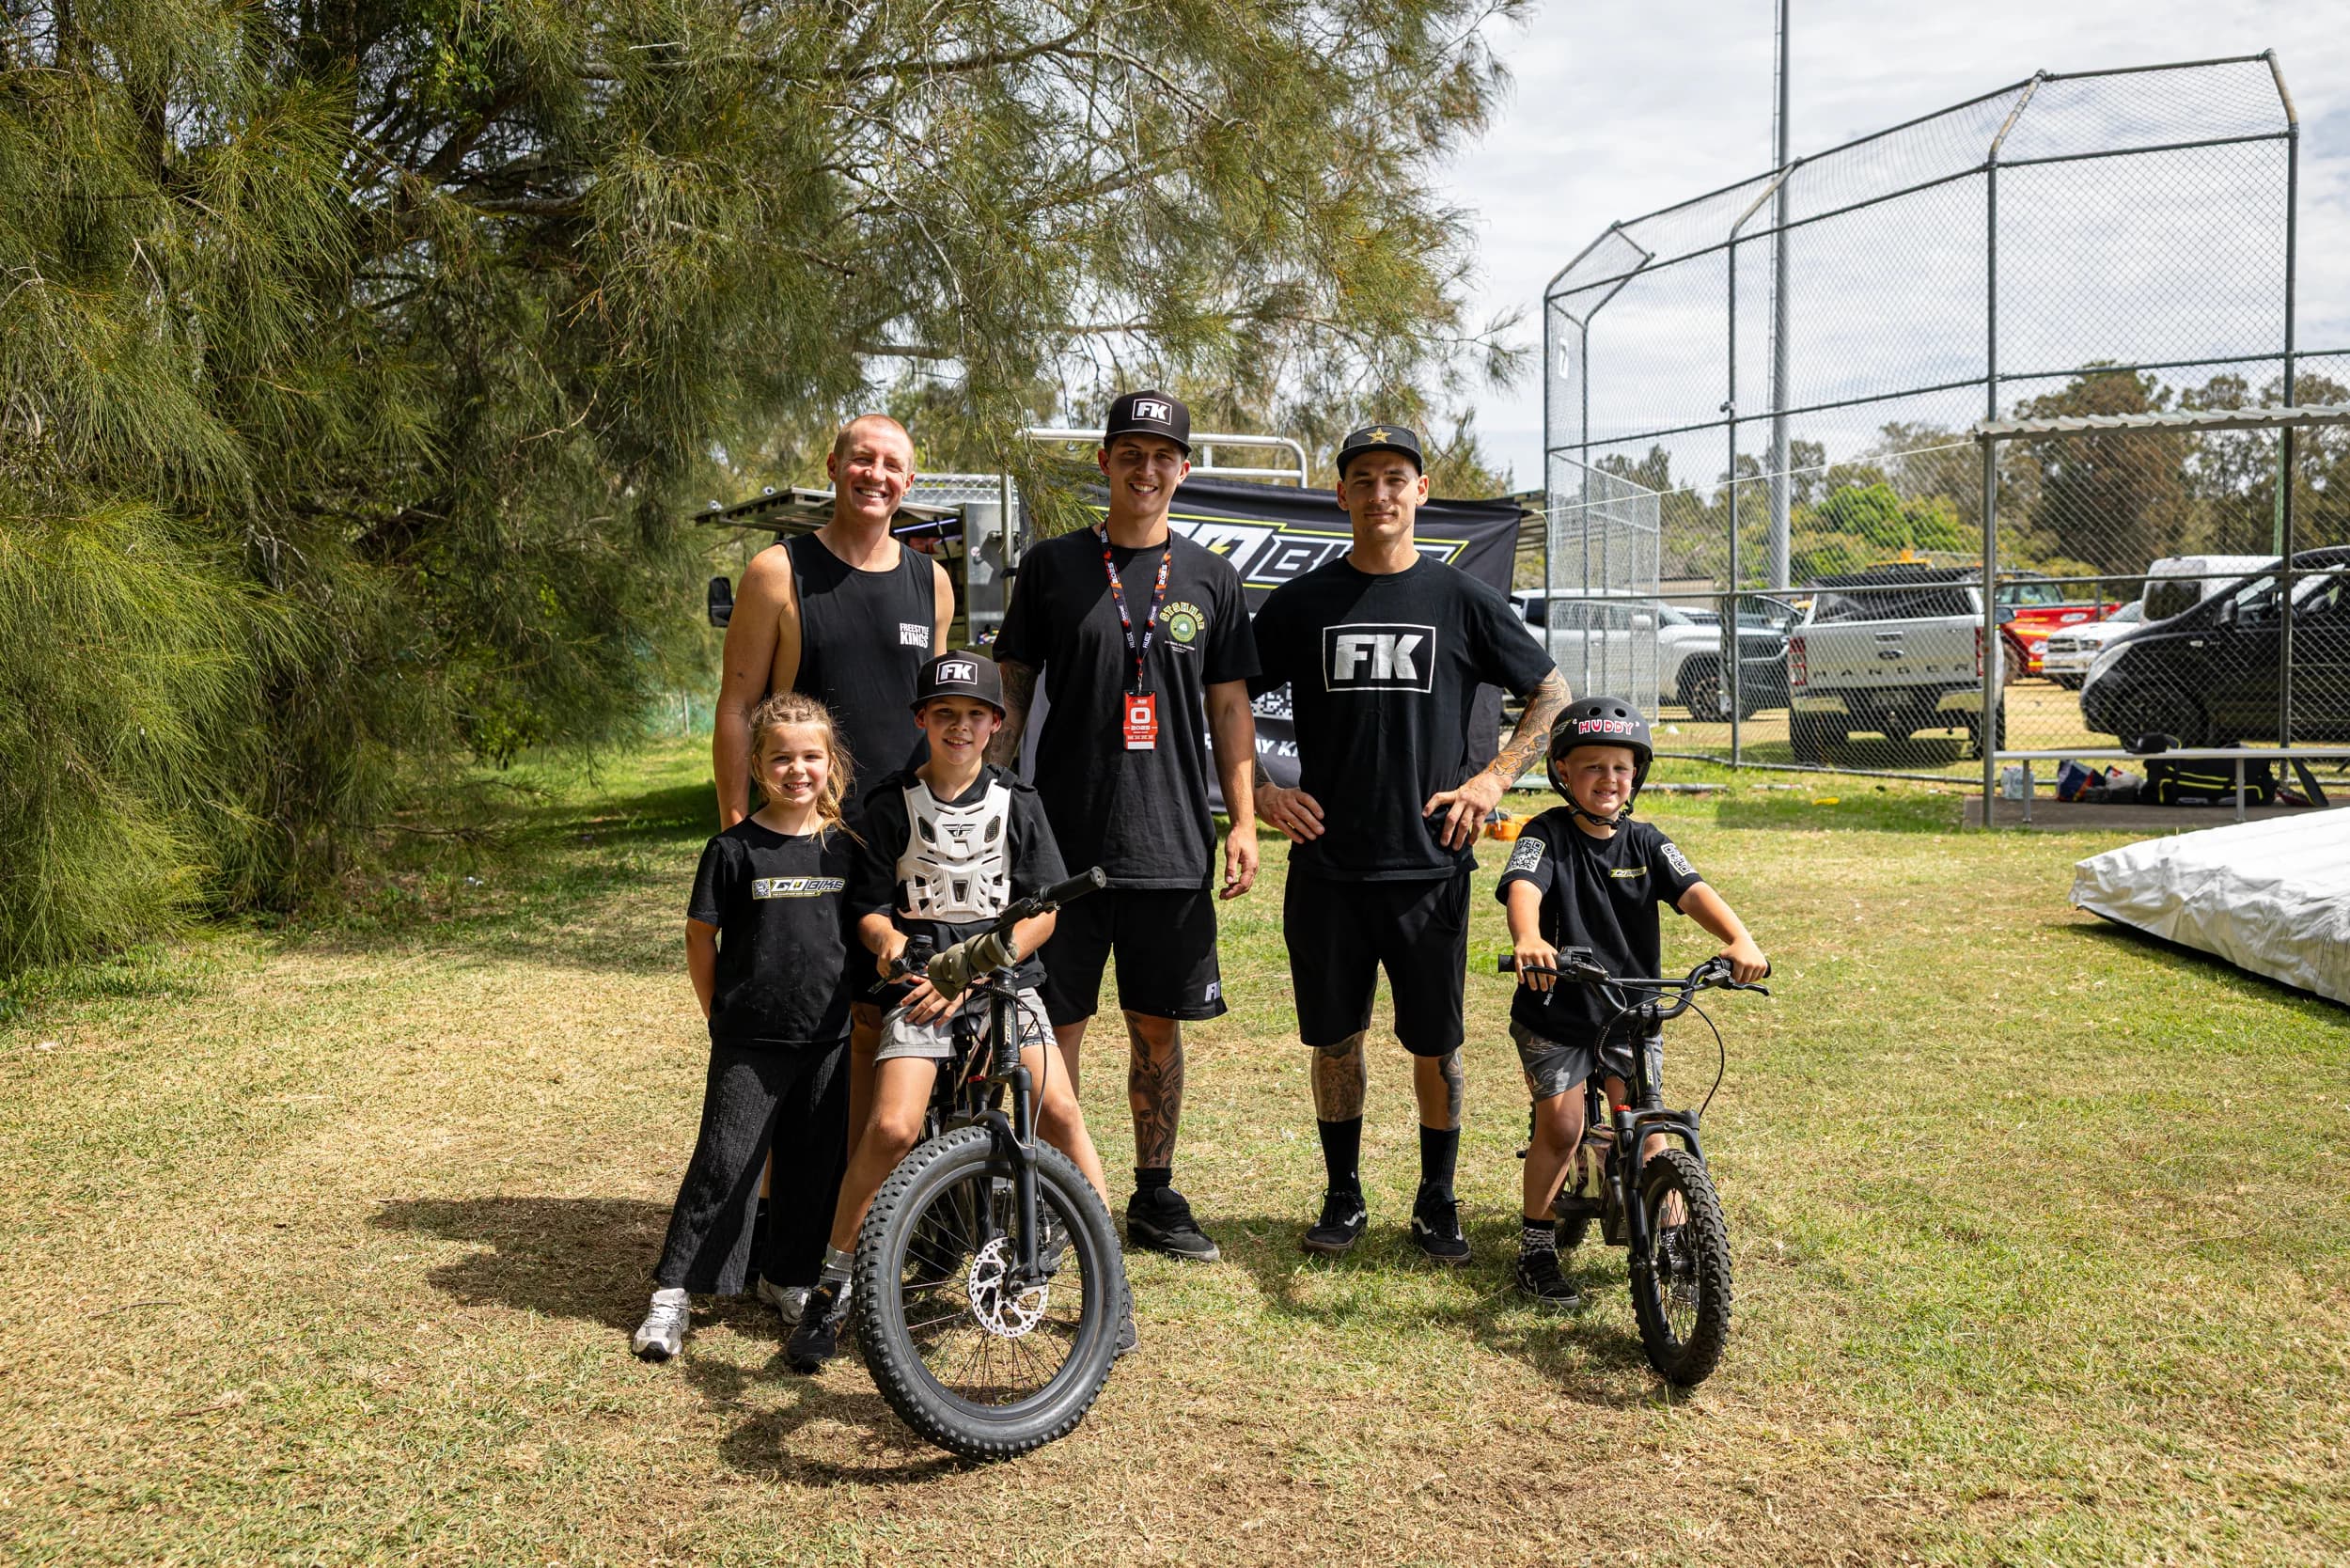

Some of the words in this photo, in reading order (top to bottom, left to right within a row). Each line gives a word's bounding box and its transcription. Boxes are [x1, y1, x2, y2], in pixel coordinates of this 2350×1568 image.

[1136, 401, 1167, 420] FK
[900, 631, 929, 649] KINGS
[1334, 634, 1424, 680] FK
[940, 663, 973, 681] FK
